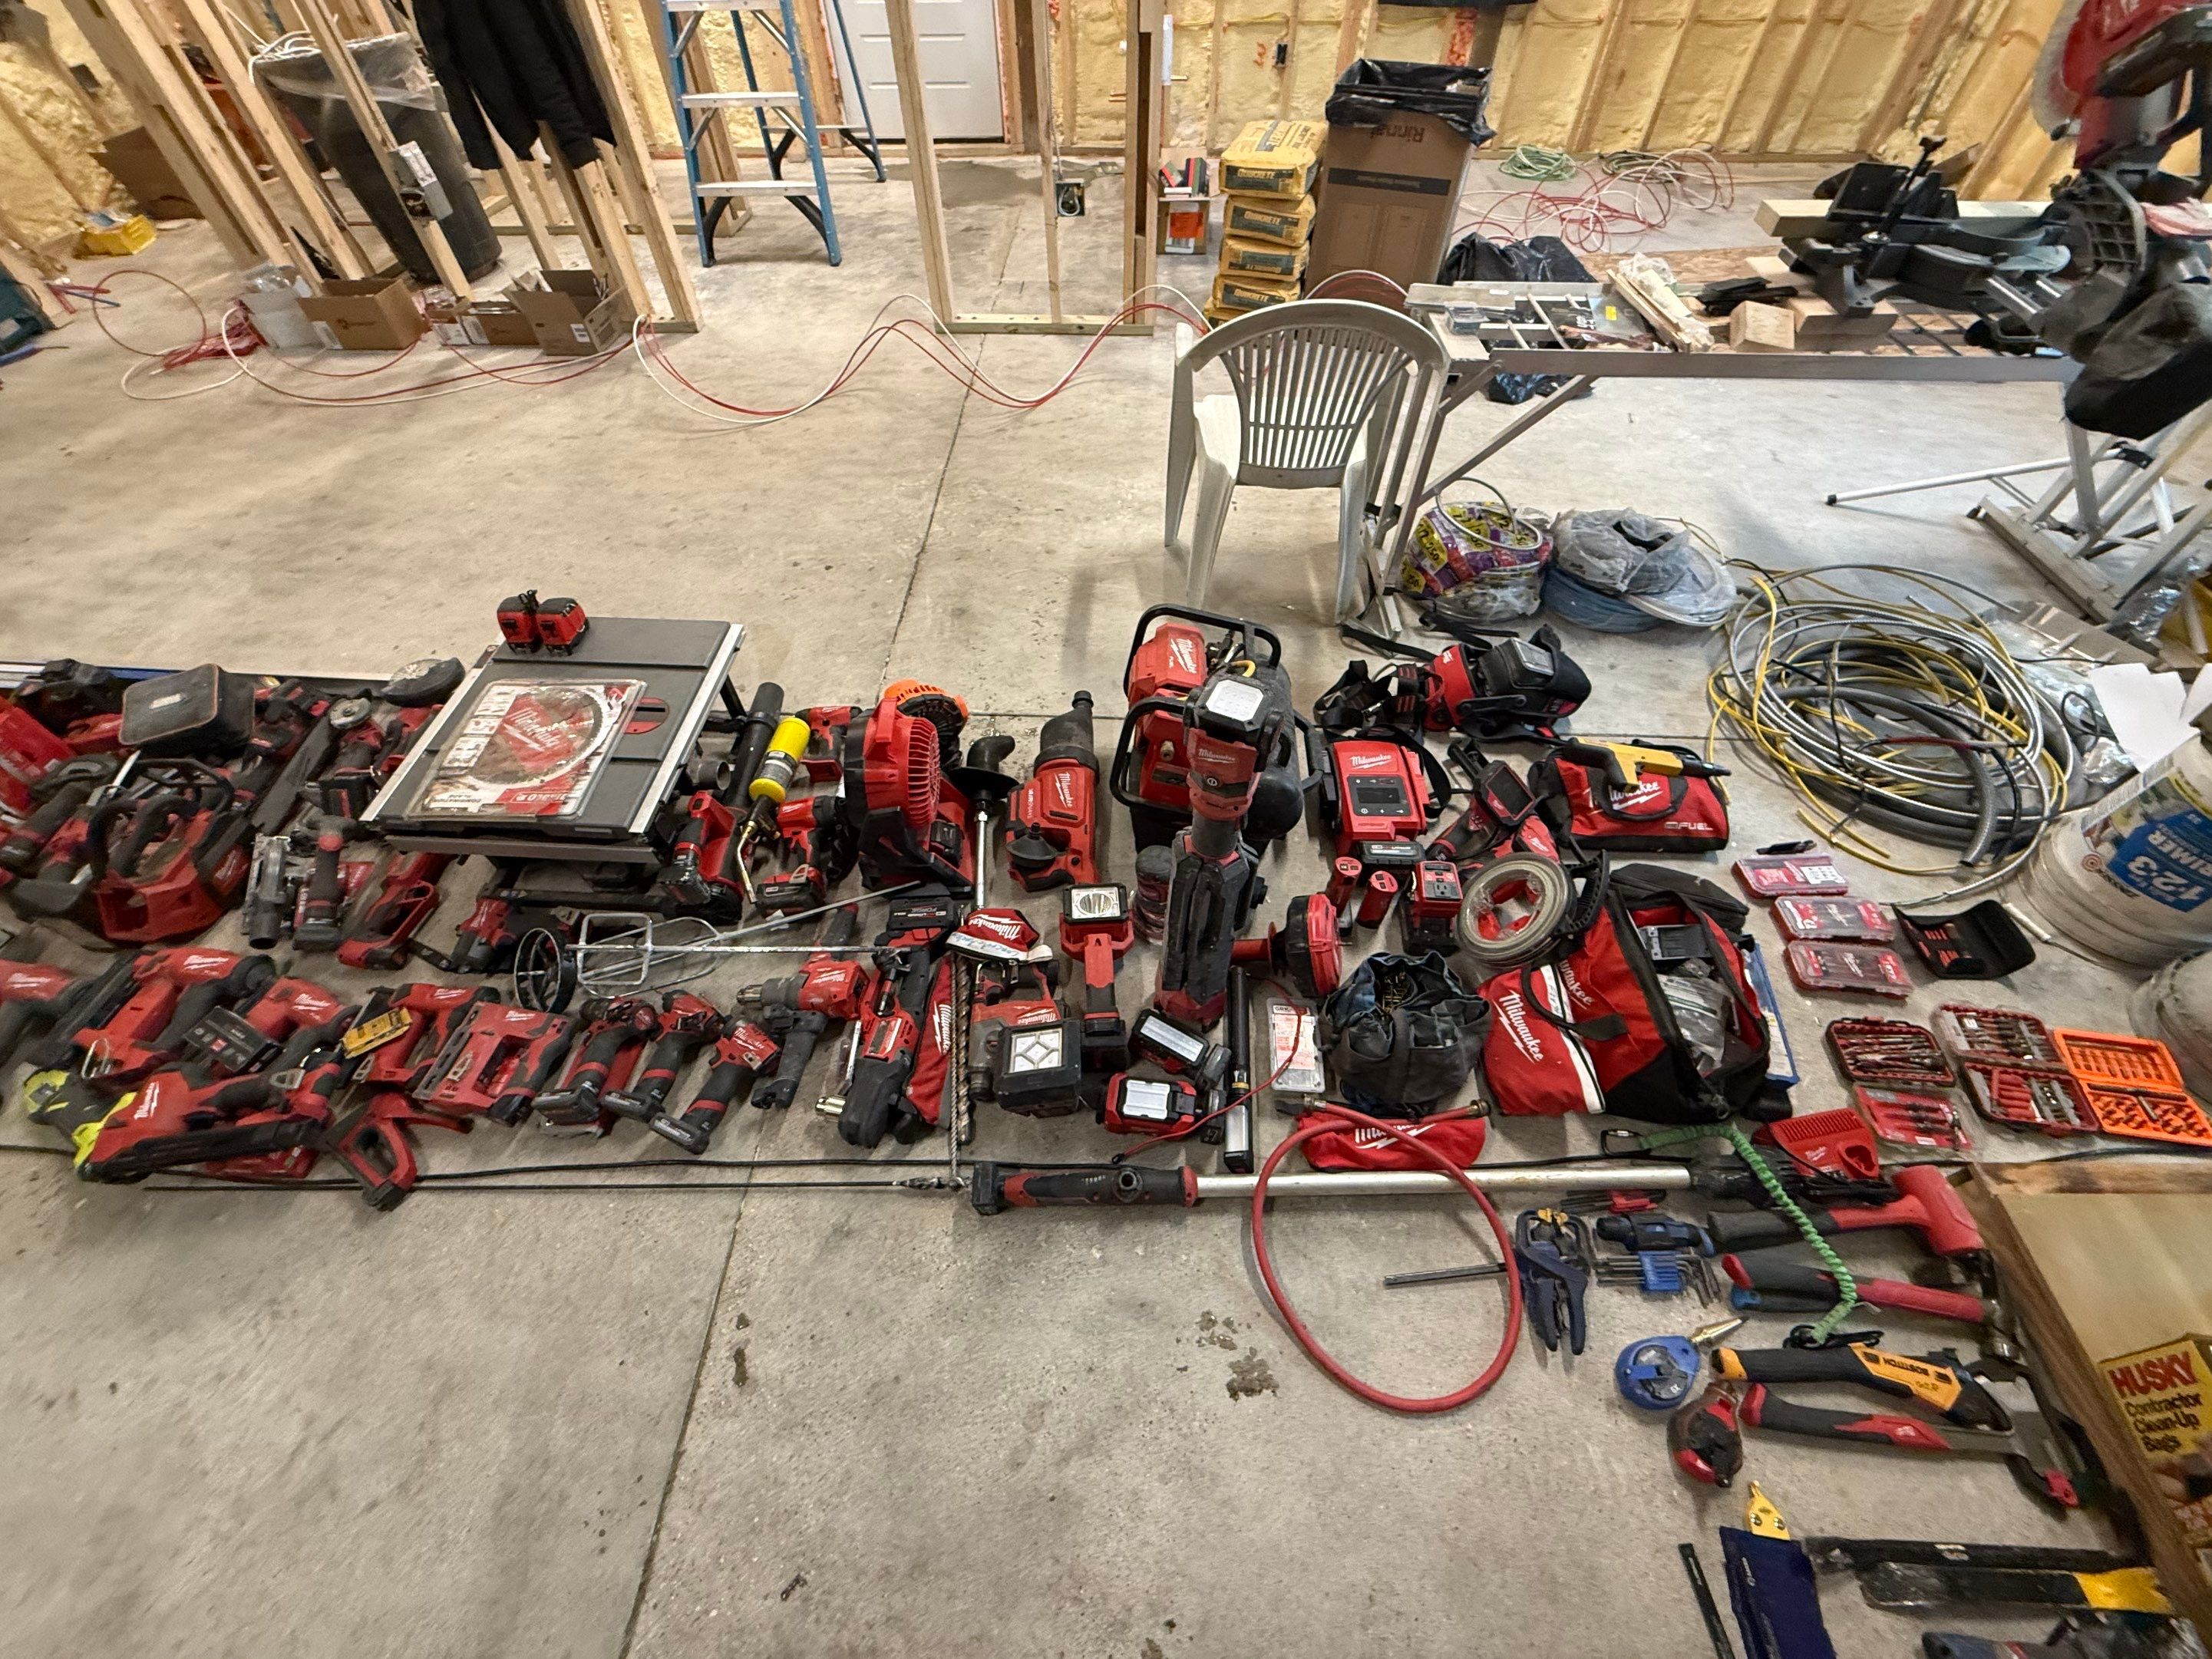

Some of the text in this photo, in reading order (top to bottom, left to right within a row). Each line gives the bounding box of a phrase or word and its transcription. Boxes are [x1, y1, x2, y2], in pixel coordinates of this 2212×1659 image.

[1349, 754, 1392, 767] Milwaukee
[1058, 771, 1074, 807] Milwaukee
[968, 917, 1022, 940] Milwaukee
[1499, 993, 1544, 1062] Milwaukee
[2108, 1351, 2199, 1400] HUSKY
[2125, 1393, 2204, 1418] Contractor
[2141, 1435, 2182, 1453] Bags
